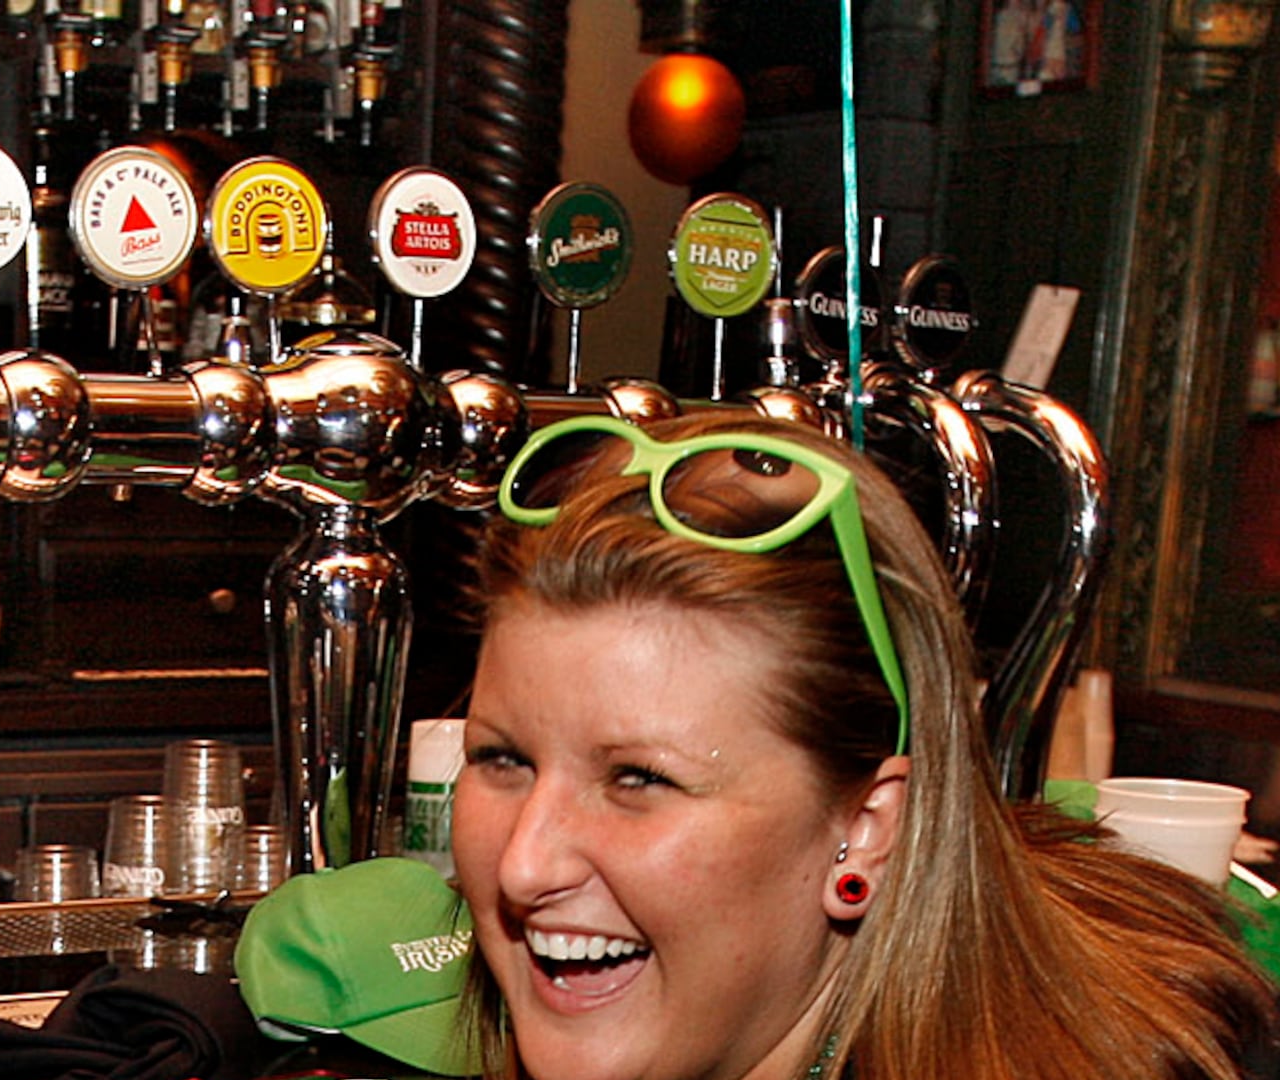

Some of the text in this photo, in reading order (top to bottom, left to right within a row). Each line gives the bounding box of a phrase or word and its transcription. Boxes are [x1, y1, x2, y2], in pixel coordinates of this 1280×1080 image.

[133, 166, 167, 189] PALE
[166, 191, 183, 217] ALE
[230, 184, 309, 237] BODDINGTONS
[404, 220, 450, 236] STELLA
[405, 236, 452, 251] ARTOIS
[688, 243, 758, 273] HARP
[910, 304, 971, 332] GUINNESS
